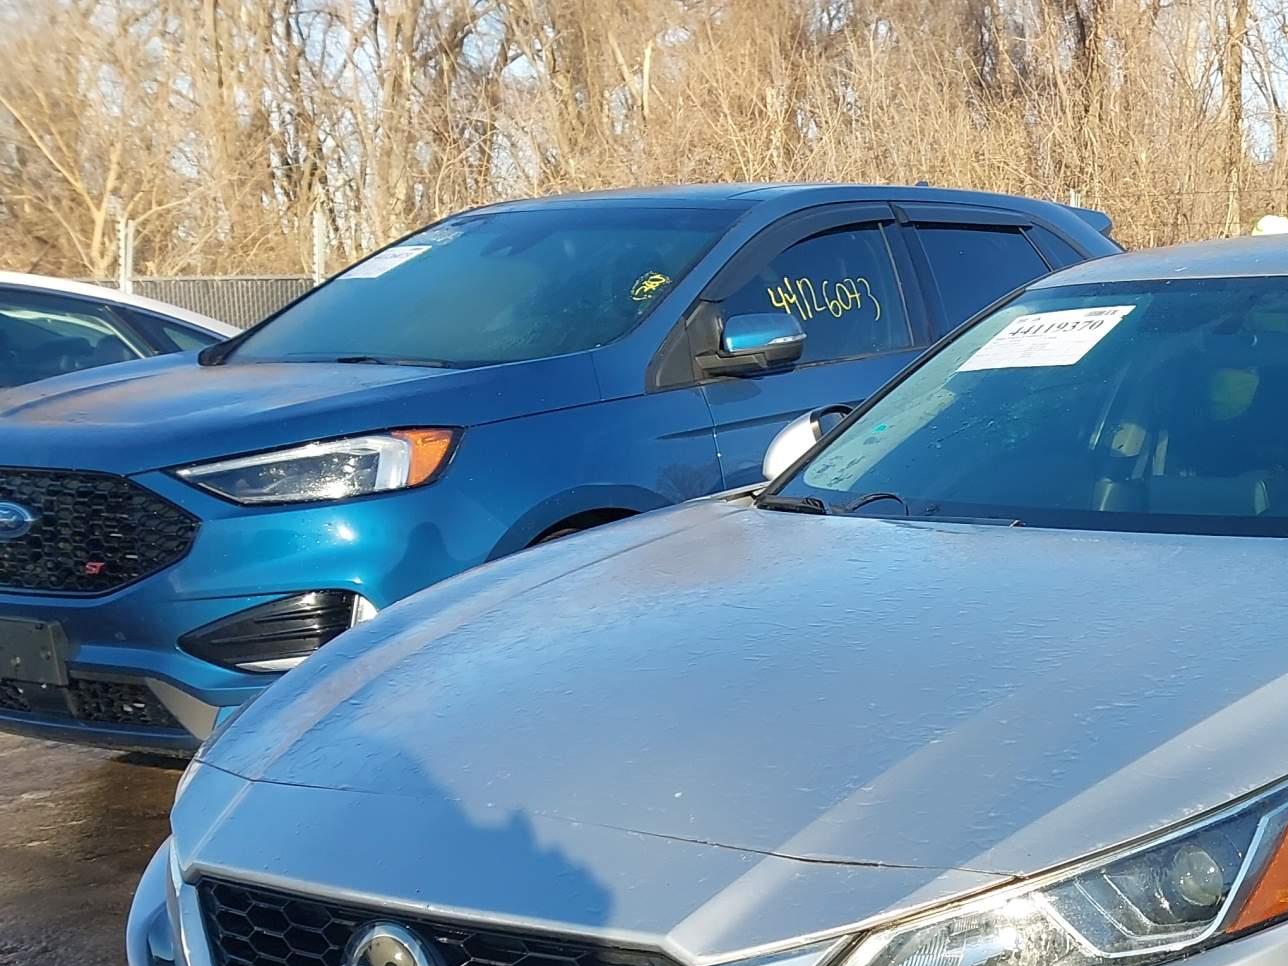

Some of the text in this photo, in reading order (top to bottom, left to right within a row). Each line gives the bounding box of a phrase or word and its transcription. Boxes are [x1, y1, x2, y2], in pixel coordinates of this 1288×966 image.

[767, 277, 881, 321] 44126073
[1009, 319, 1105, 337] 44119370
[85, 561, 105, 575] ST
